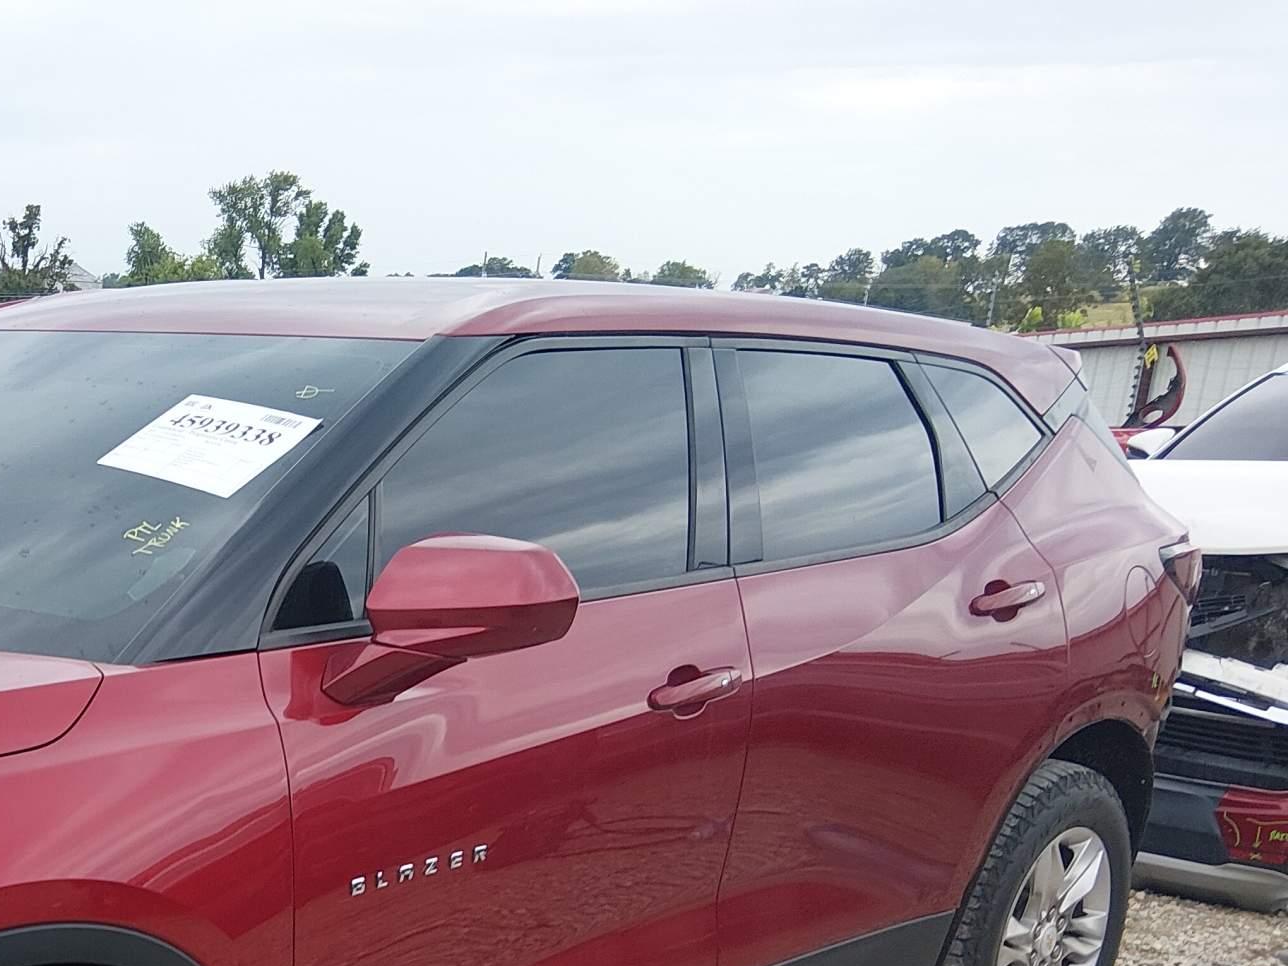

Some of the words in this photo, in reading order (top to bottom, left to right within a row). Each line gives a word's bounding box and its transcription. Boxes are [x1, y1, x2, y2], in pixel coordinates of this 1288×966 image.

[170, 414, 282, 446] 45939338
[132, 516, 191, 557] TRUNK
[351, 844, 488, 897] BLAZER
